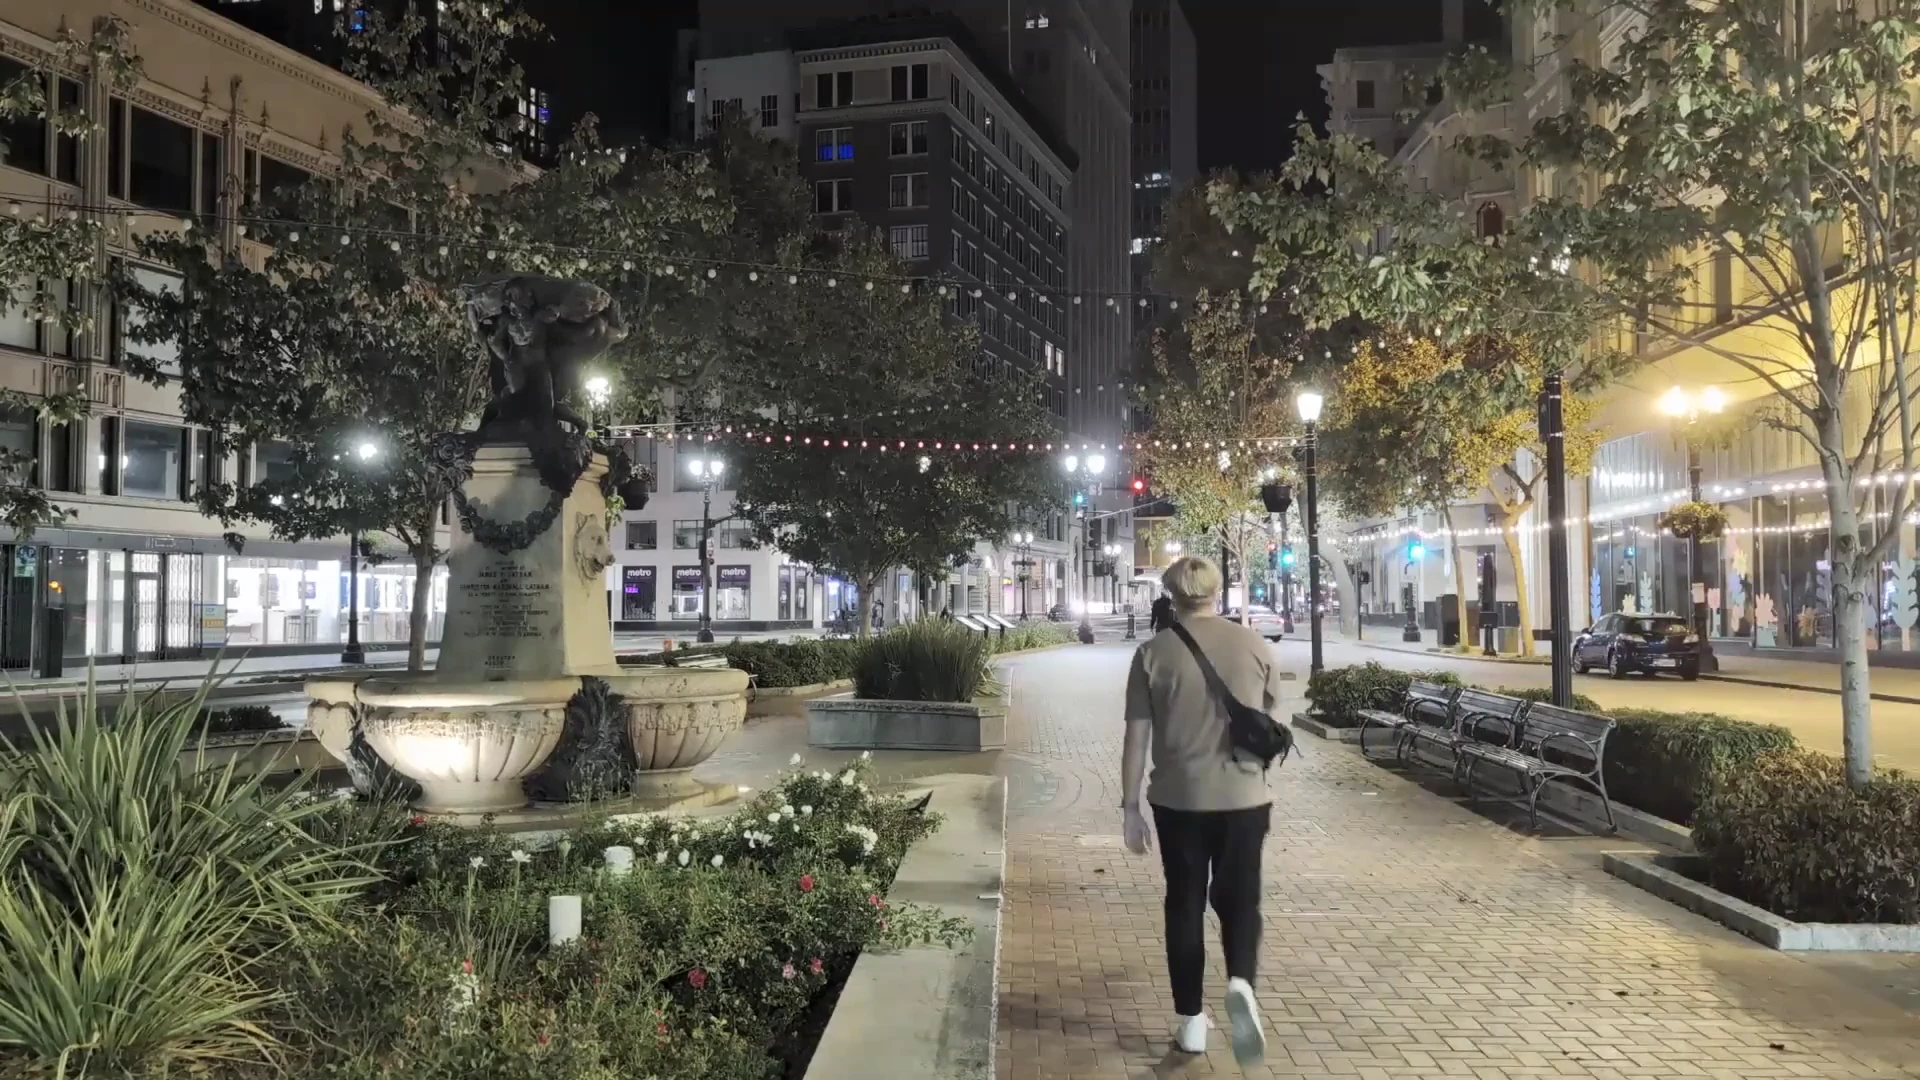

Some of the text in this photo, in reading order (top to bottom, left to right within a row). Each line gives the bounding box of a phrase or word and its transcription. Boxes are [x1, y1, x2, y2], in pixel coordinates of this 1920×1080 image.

[627, 568, 652, 579] metro
[676, 568, 701, 579] metro
[721, 567, 746, 578] metro
